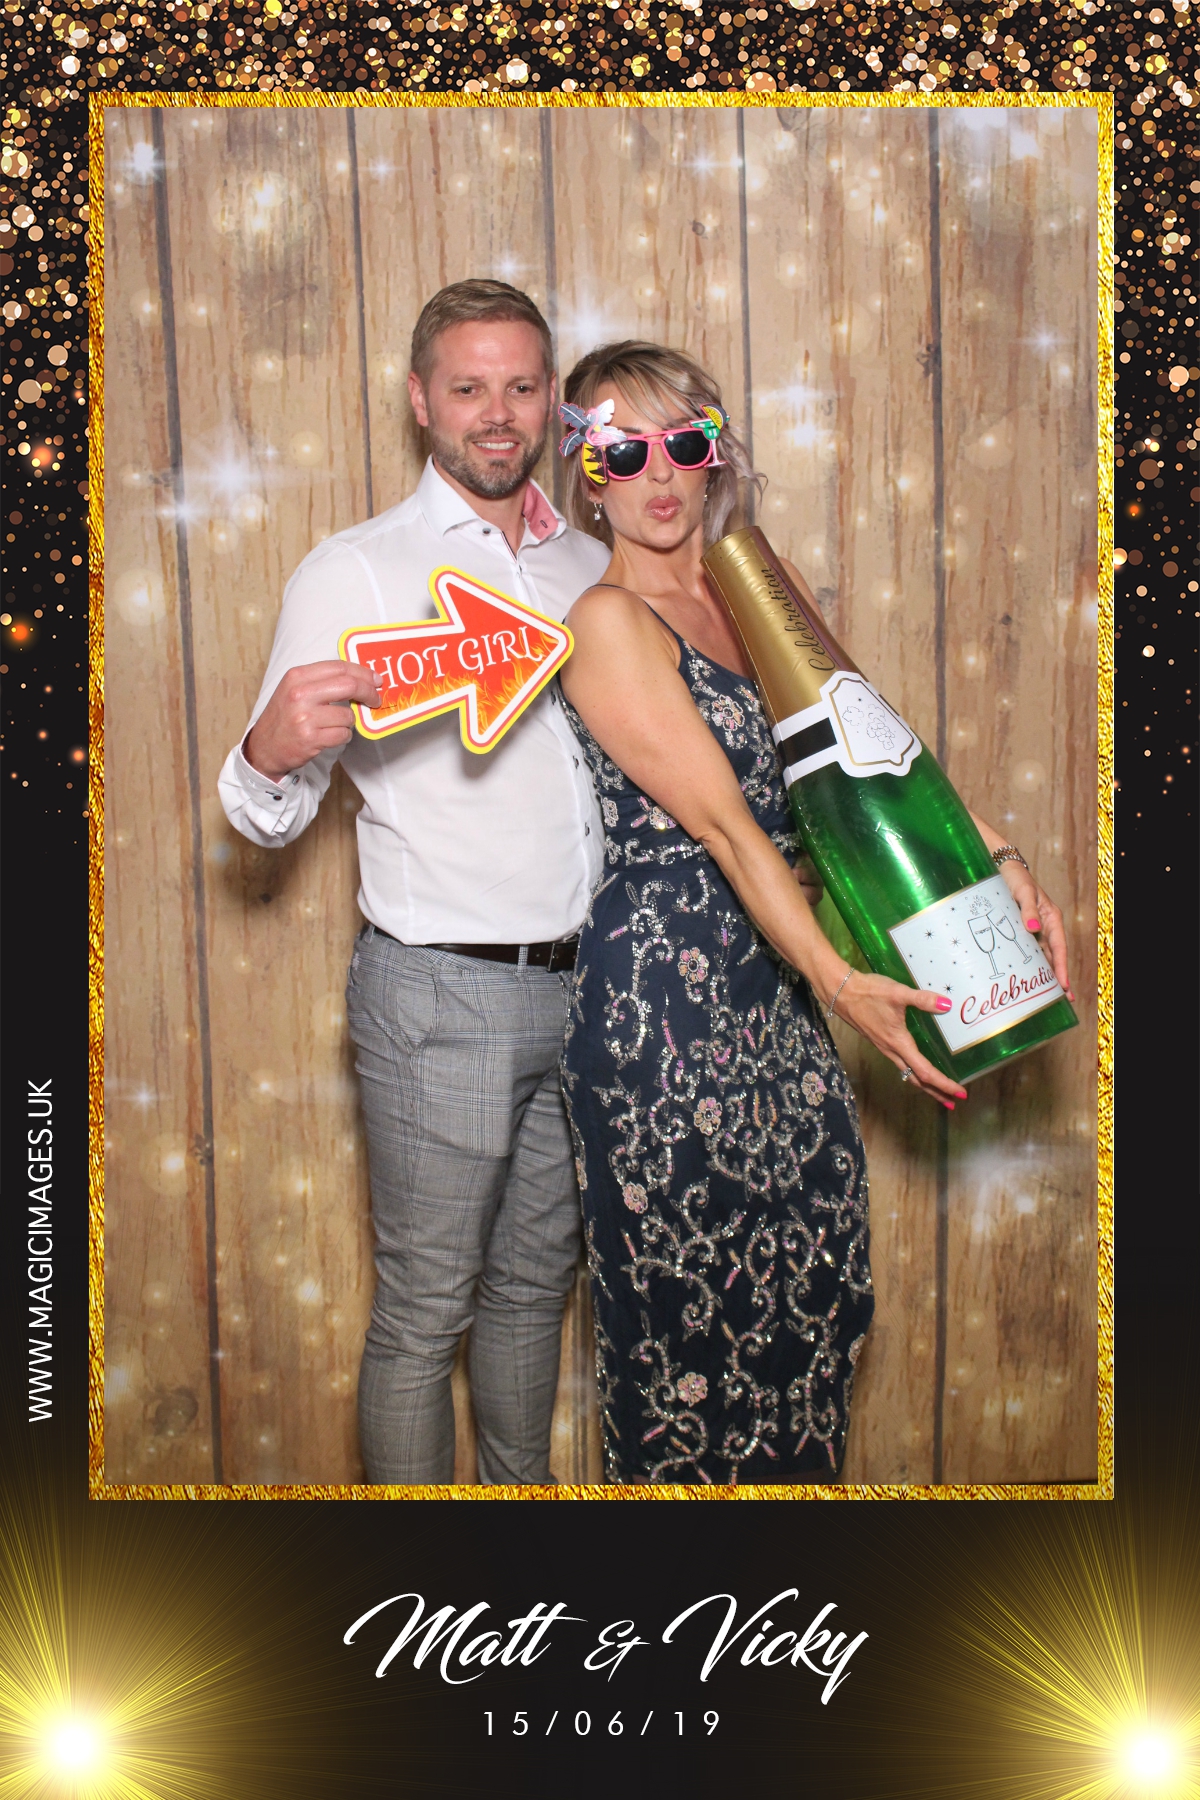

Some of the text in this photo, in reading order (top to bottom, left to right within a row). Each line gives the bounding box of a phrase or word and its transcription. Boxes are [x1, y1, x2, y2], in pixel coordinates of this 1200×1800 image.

[366, 626, 543, 691] HOT GIRL
[761, 568, 836, 671] Celebration
